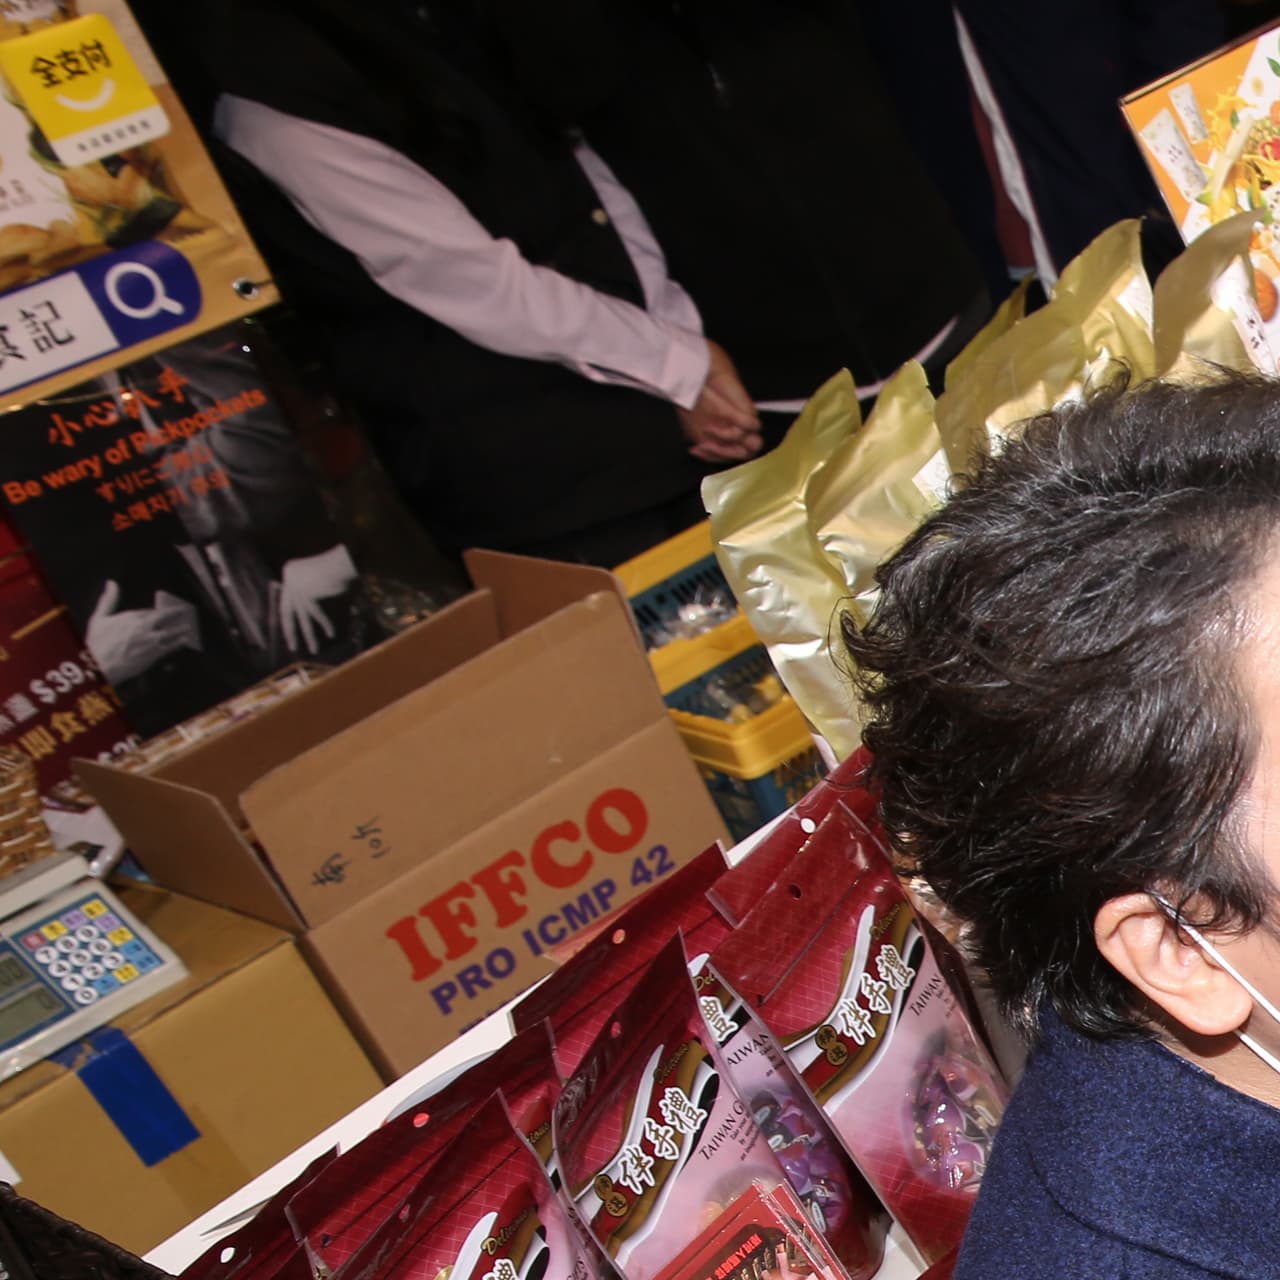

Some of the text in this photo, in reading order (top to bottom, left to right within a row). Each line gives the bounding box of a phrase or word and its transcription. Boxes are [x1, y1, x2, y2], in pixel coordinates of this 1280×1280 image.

[30, 39, 113, 89] 全支付
[2, 478, 43, 505] Be
[42, 455, 104, 490] wary
[104, 437, 131, 466] of
[386, 787, 650, 982] IFFCO
[429, 947, 517, 1015] PRO
[523, 878, 618, 957] ICMP
[630, 844, 676, 889] 42
[839, 944, 916, 1046] 伴手禮
[908, 973, 943, 1017] TAIWAN
[727, 1033, 769, 1067] AIWAN
[619, 1086, 708, 1195] 伴手禮
[699, 1114, 737, 1161] TAIWAN
